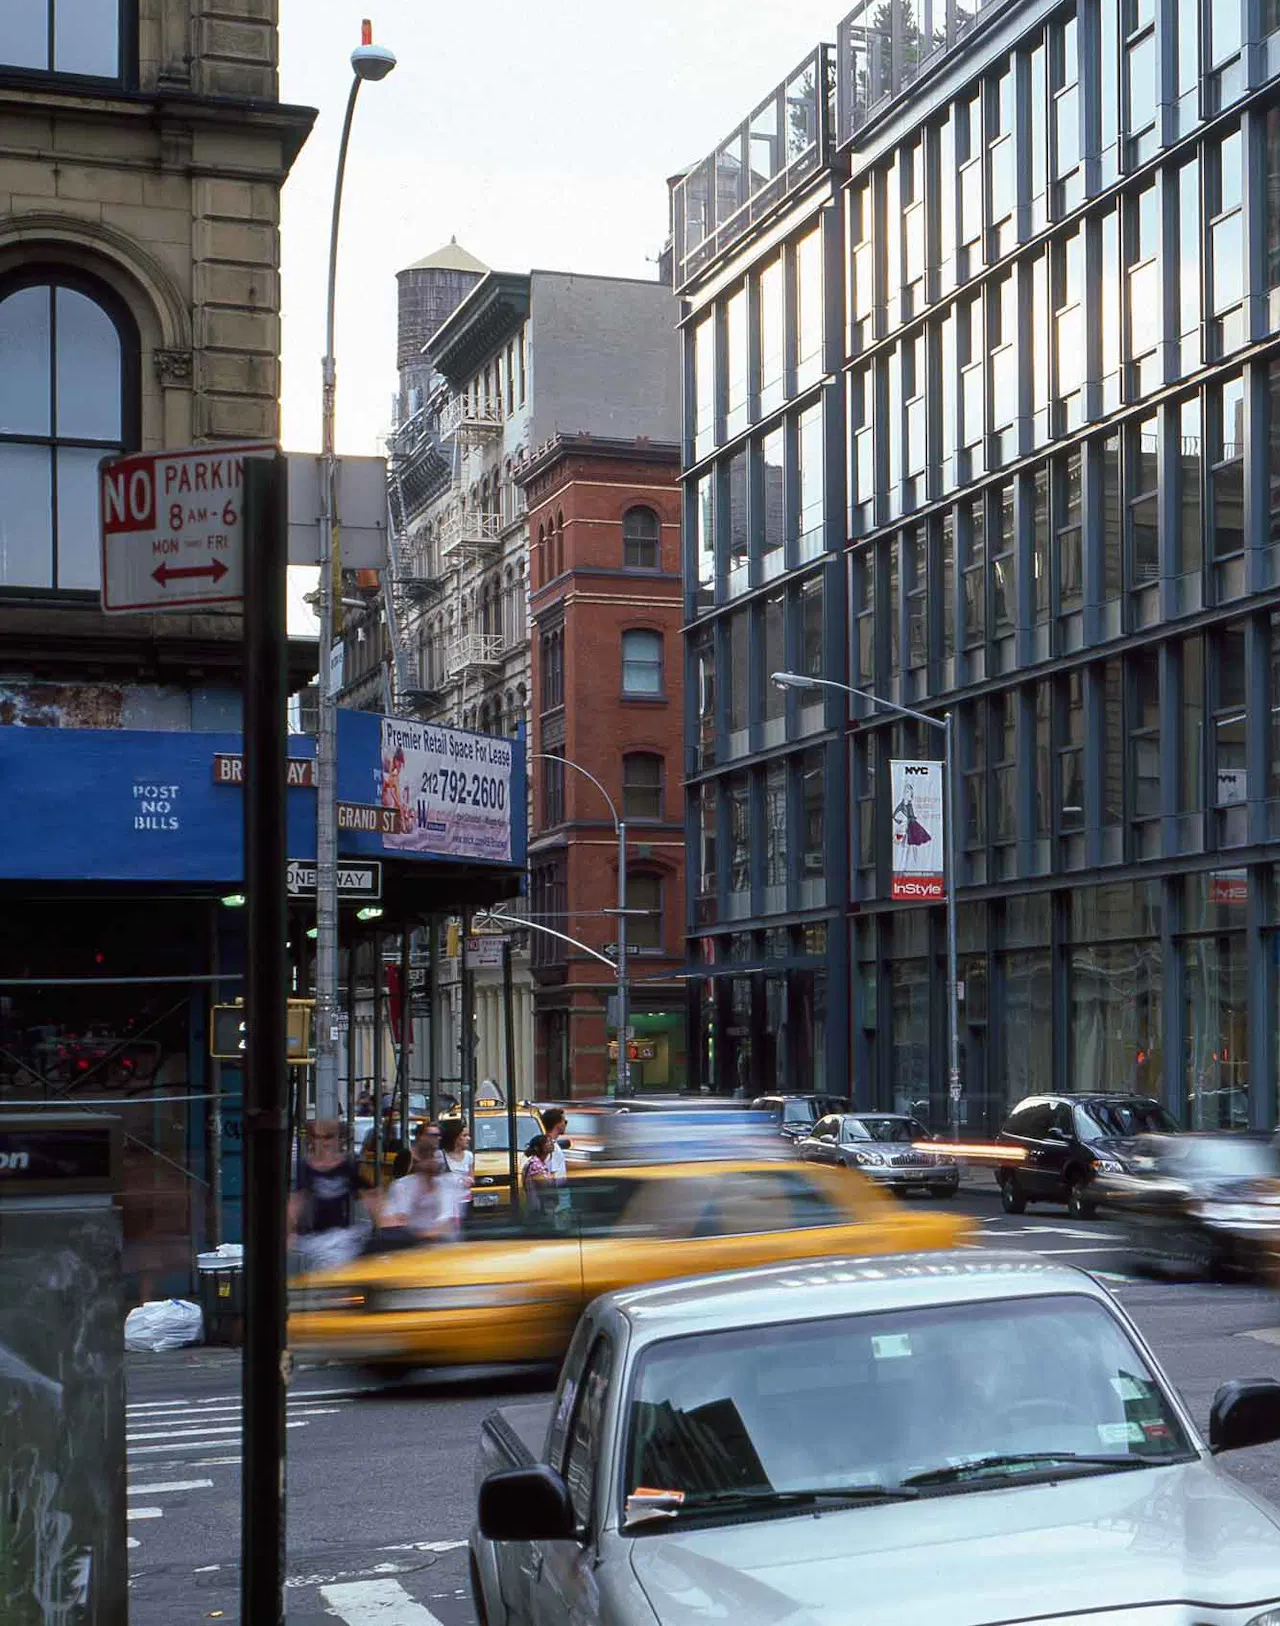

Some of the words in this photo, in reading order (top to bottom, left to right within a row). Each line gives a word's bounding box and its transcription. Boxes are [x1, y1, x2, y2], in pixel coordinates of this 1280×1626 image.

[103, 469, 151, 524] NO
[165, 459, 244, 495] PARKIN
[152, 539, 179, 555] MON
[207, 535, 229, 550] FRI
[386, 723, 421, 749] Premier
[423, 730, 447, 756] Retail
[449, 734, 474, 761] Space
[475, 740, 487, 762] For
[489, 744, 511, 767] Lease
[905, 766, 928, 775] NYC
[132, 785, 179, 799] POST
[439, 769, 505, 810] 792-2600
[141, 801, 171, 813] NO
[134, 816, 179, 830] BILLS
[338, 806, 377, 830] GRAND
[382, 812, 396, 832] ST
[893, 883, 941, 895] InStyle
